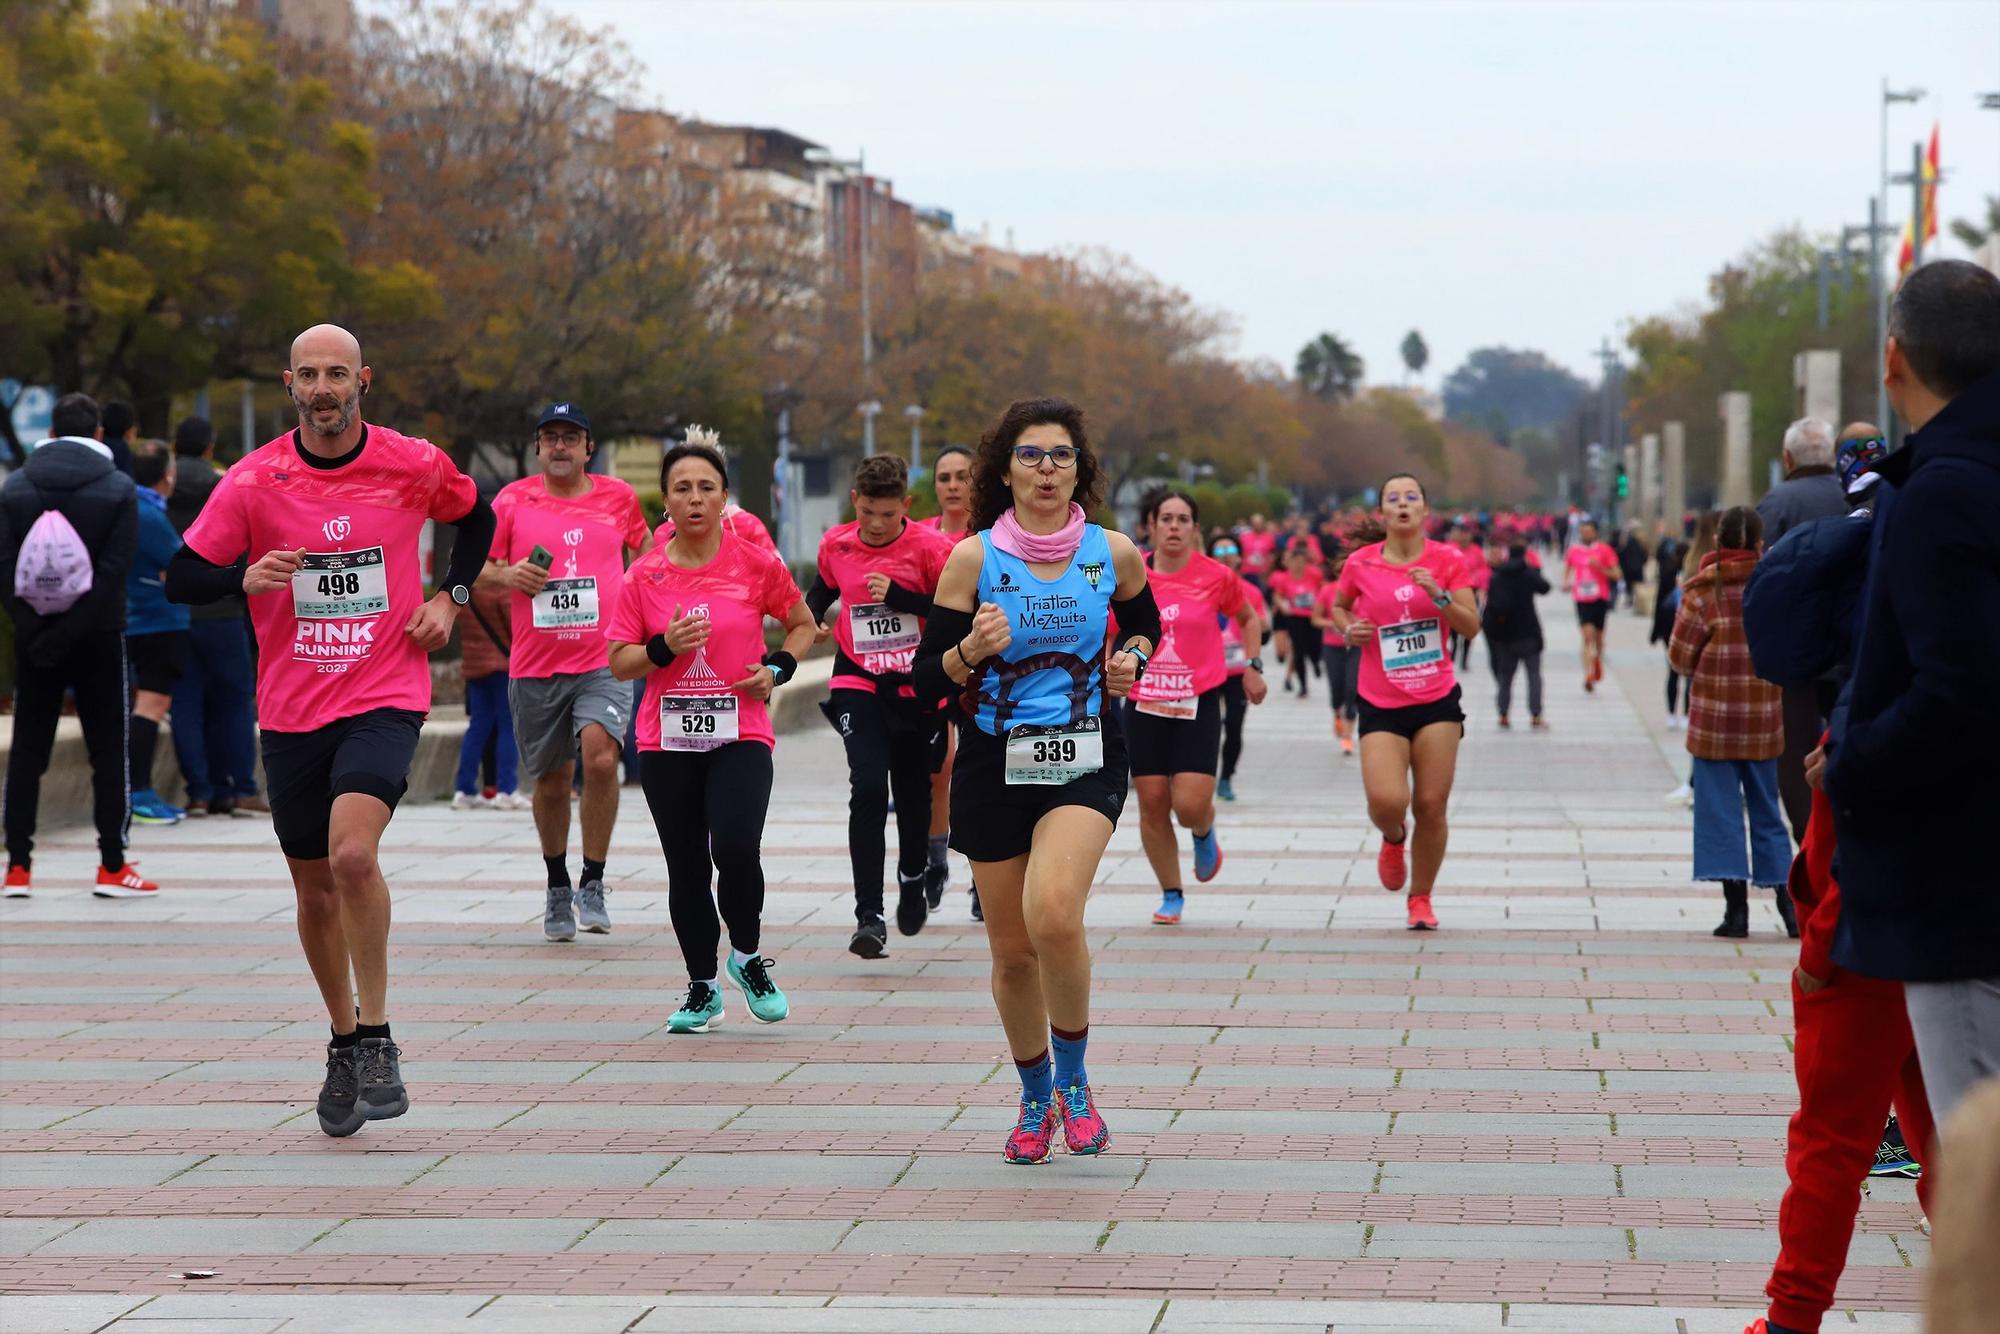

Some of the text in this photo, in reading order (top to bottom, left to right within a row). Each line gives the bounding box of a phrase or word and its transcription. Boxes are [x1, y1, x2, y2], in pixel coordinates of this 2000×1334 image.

[317, 572, 360, 596] 498
[551, 594, 580, 609] 434
[296, 621, 376, 643] PINK
[867, 617, 901, 635] 1126
[1040, 634, 1079, 645] IMDECO
[1396, 634, 1426, 653] 2110
[294, 643, 371, 656] RUNNING
[317, 664, 348, 673] 2023
[1140, 673, 1193, 689] PINK
[1139, 686, 1194, 698] RUNNING
[682, 715, 715, 733] 529
[1033, 739, 1076, 762] 339
